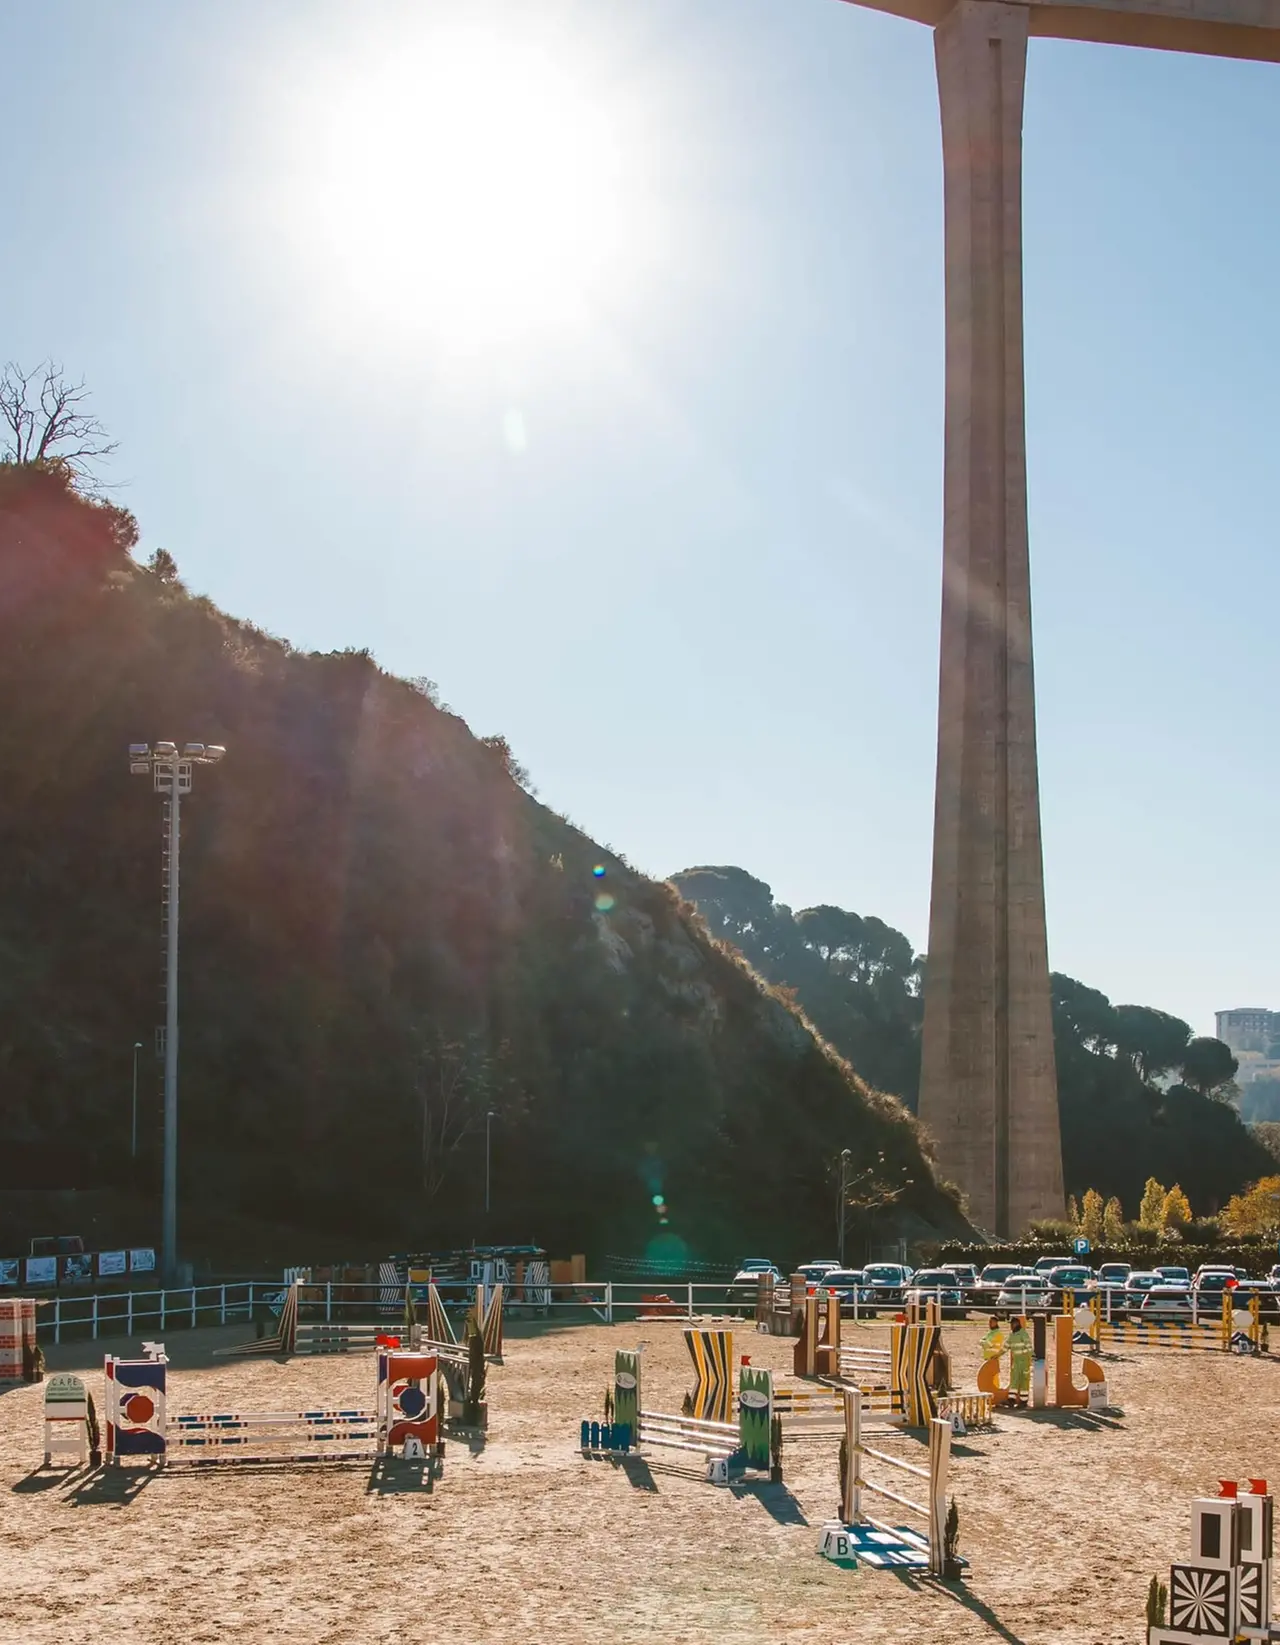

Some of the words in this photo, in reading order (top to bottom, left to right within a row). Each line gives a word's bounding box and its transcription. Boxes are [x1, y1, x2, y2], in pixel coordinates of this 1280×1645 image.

[1077, 1240, 1086, 1252] P
[412, 1442, 418, 1456] 2
[837, 1537, 848, 1555] B
